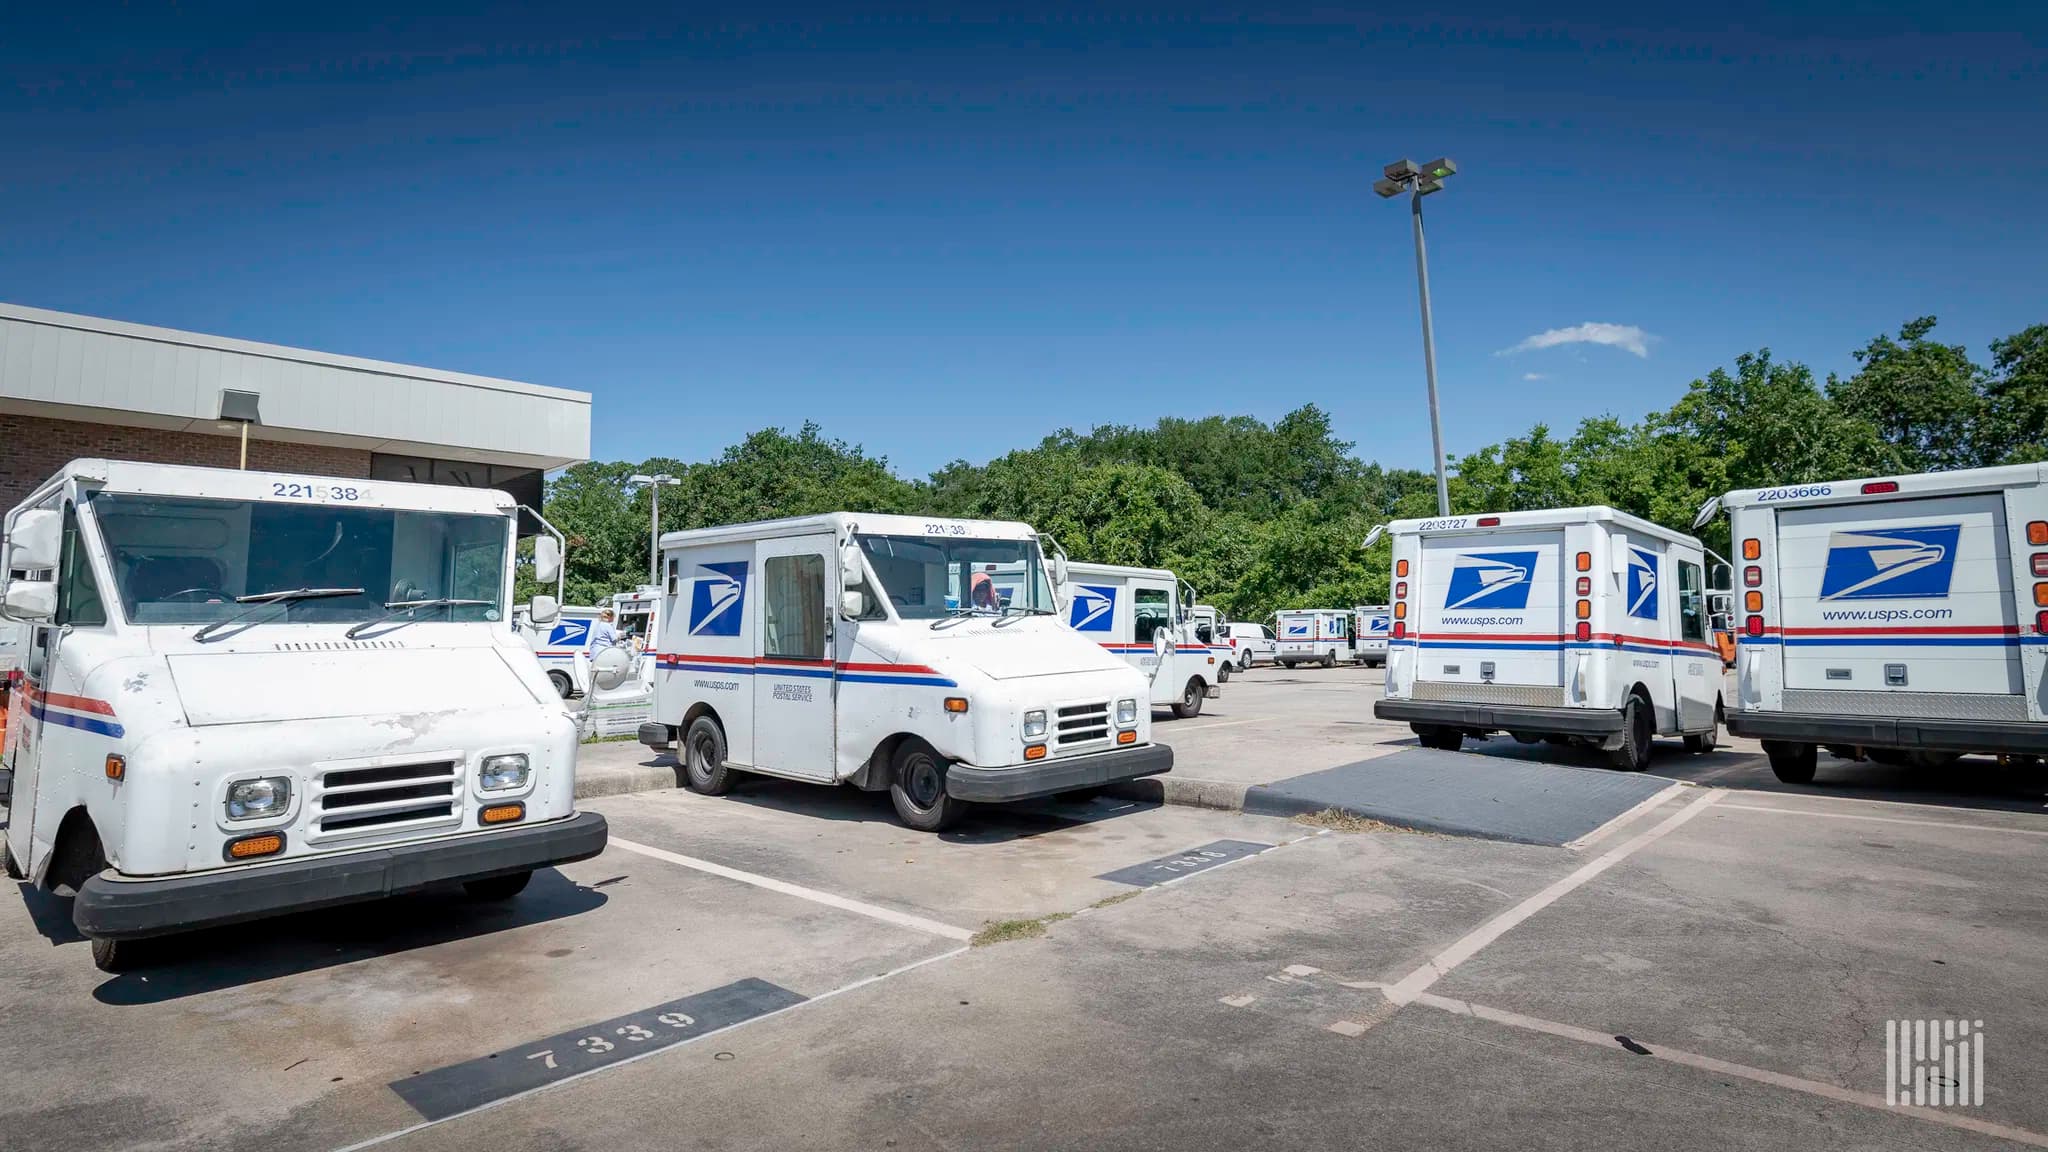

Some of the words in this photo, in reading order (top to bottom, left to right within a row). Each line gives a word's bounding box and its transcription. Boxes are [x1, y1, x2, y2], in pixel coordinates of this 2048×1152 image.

[1757, 485, 1832, 501] 2203666
[1419, 519, 1468, 530] 2203727
[1822, 608, 1953, 622] www.usps.com
[1441, 616, 1523, 627] www.usps.com
[693, 679, 739, 691] www.usps.com
[773, 683, 792, 691] UNITED
[793, 684, 812, 693] STATES
[791, 692, 813, 702] SERVICE
[526, 1012, 695, 1068] 7339
